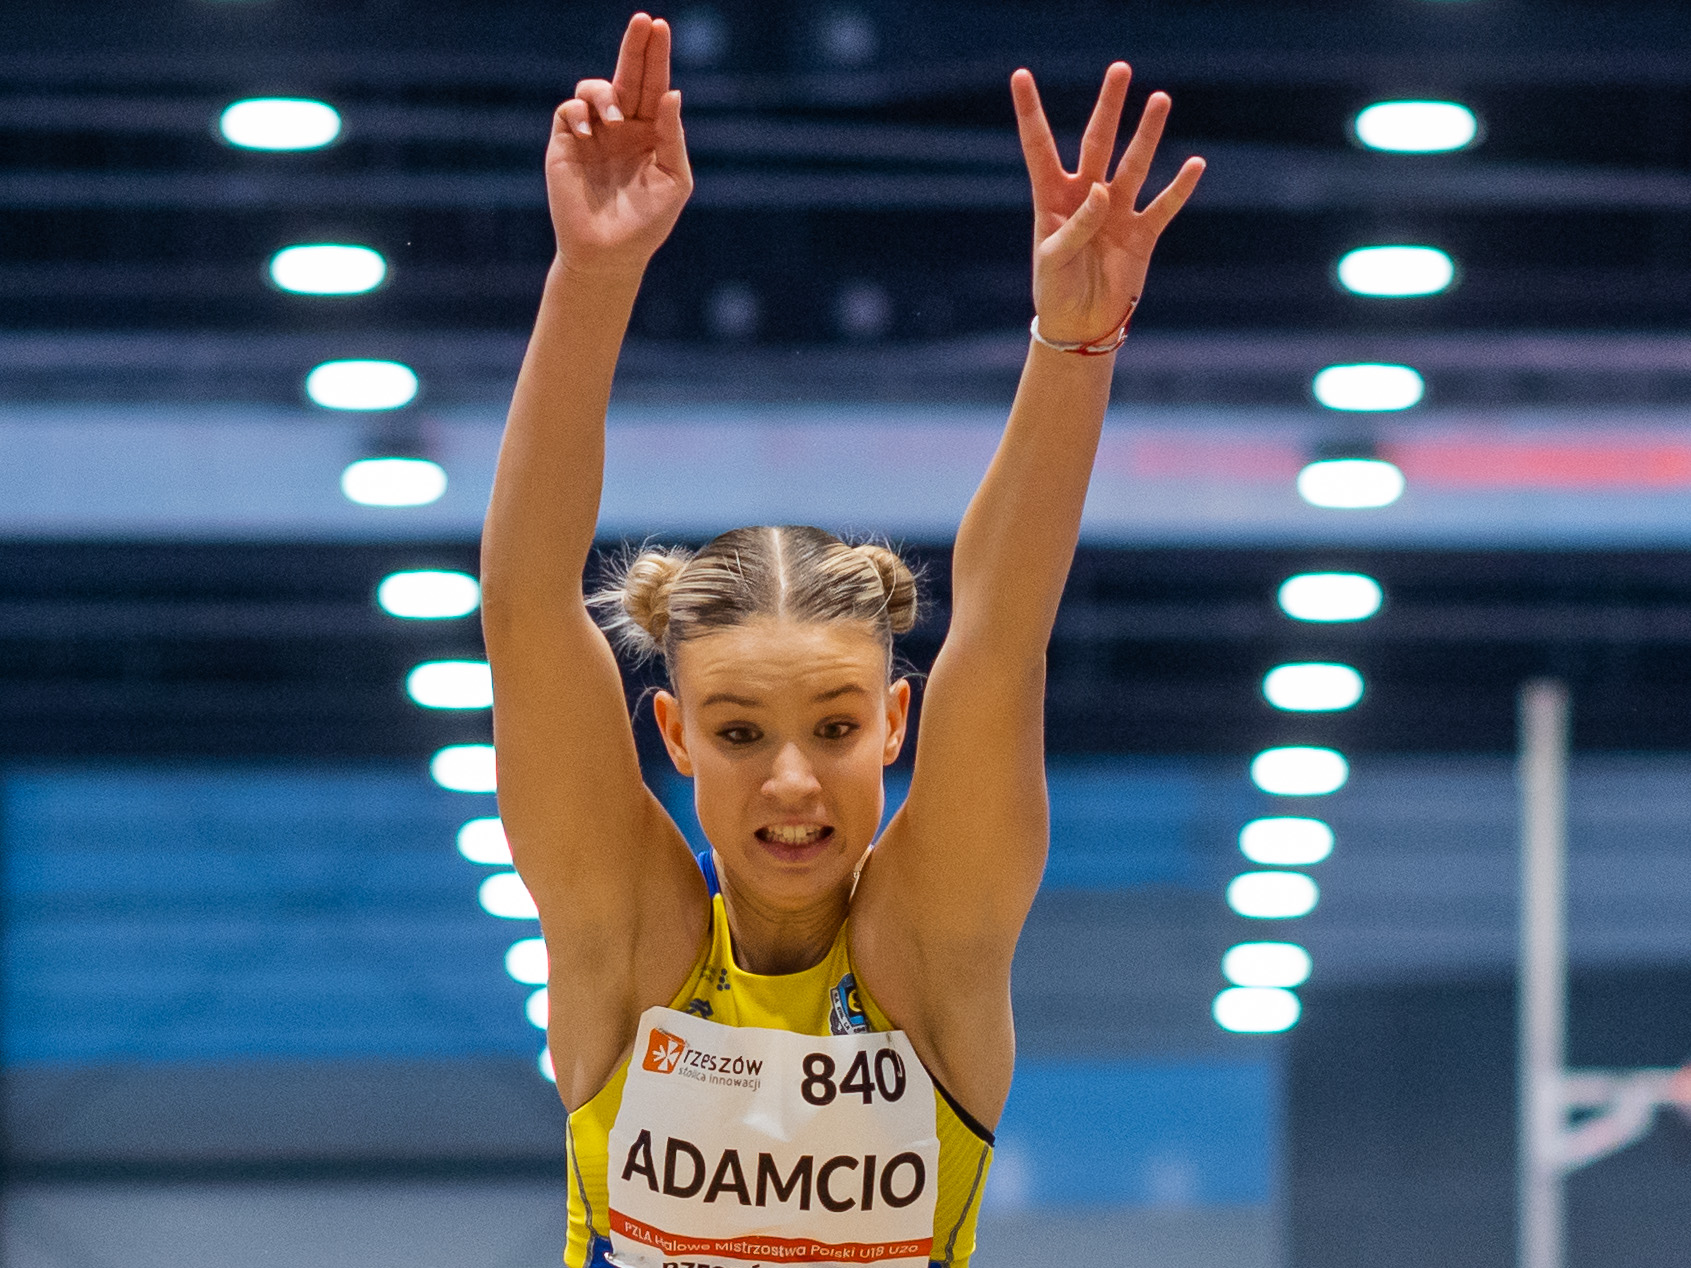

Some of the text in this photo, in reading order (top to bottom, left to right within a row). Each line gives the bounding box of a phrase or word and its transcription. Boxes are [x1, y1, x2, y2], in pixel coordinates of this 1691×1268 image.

[678, 1067, 761, 1092] stolica innowacji
[683, 1049, 763, 1075] rzeszów
[801, 1047, 906, 1106] 840
[621, 1128, 926, 1212] ADAMCIO
[624, 1221, 918, 1259] PZLA Halowe Mistrzostwa Polski U18 U20
